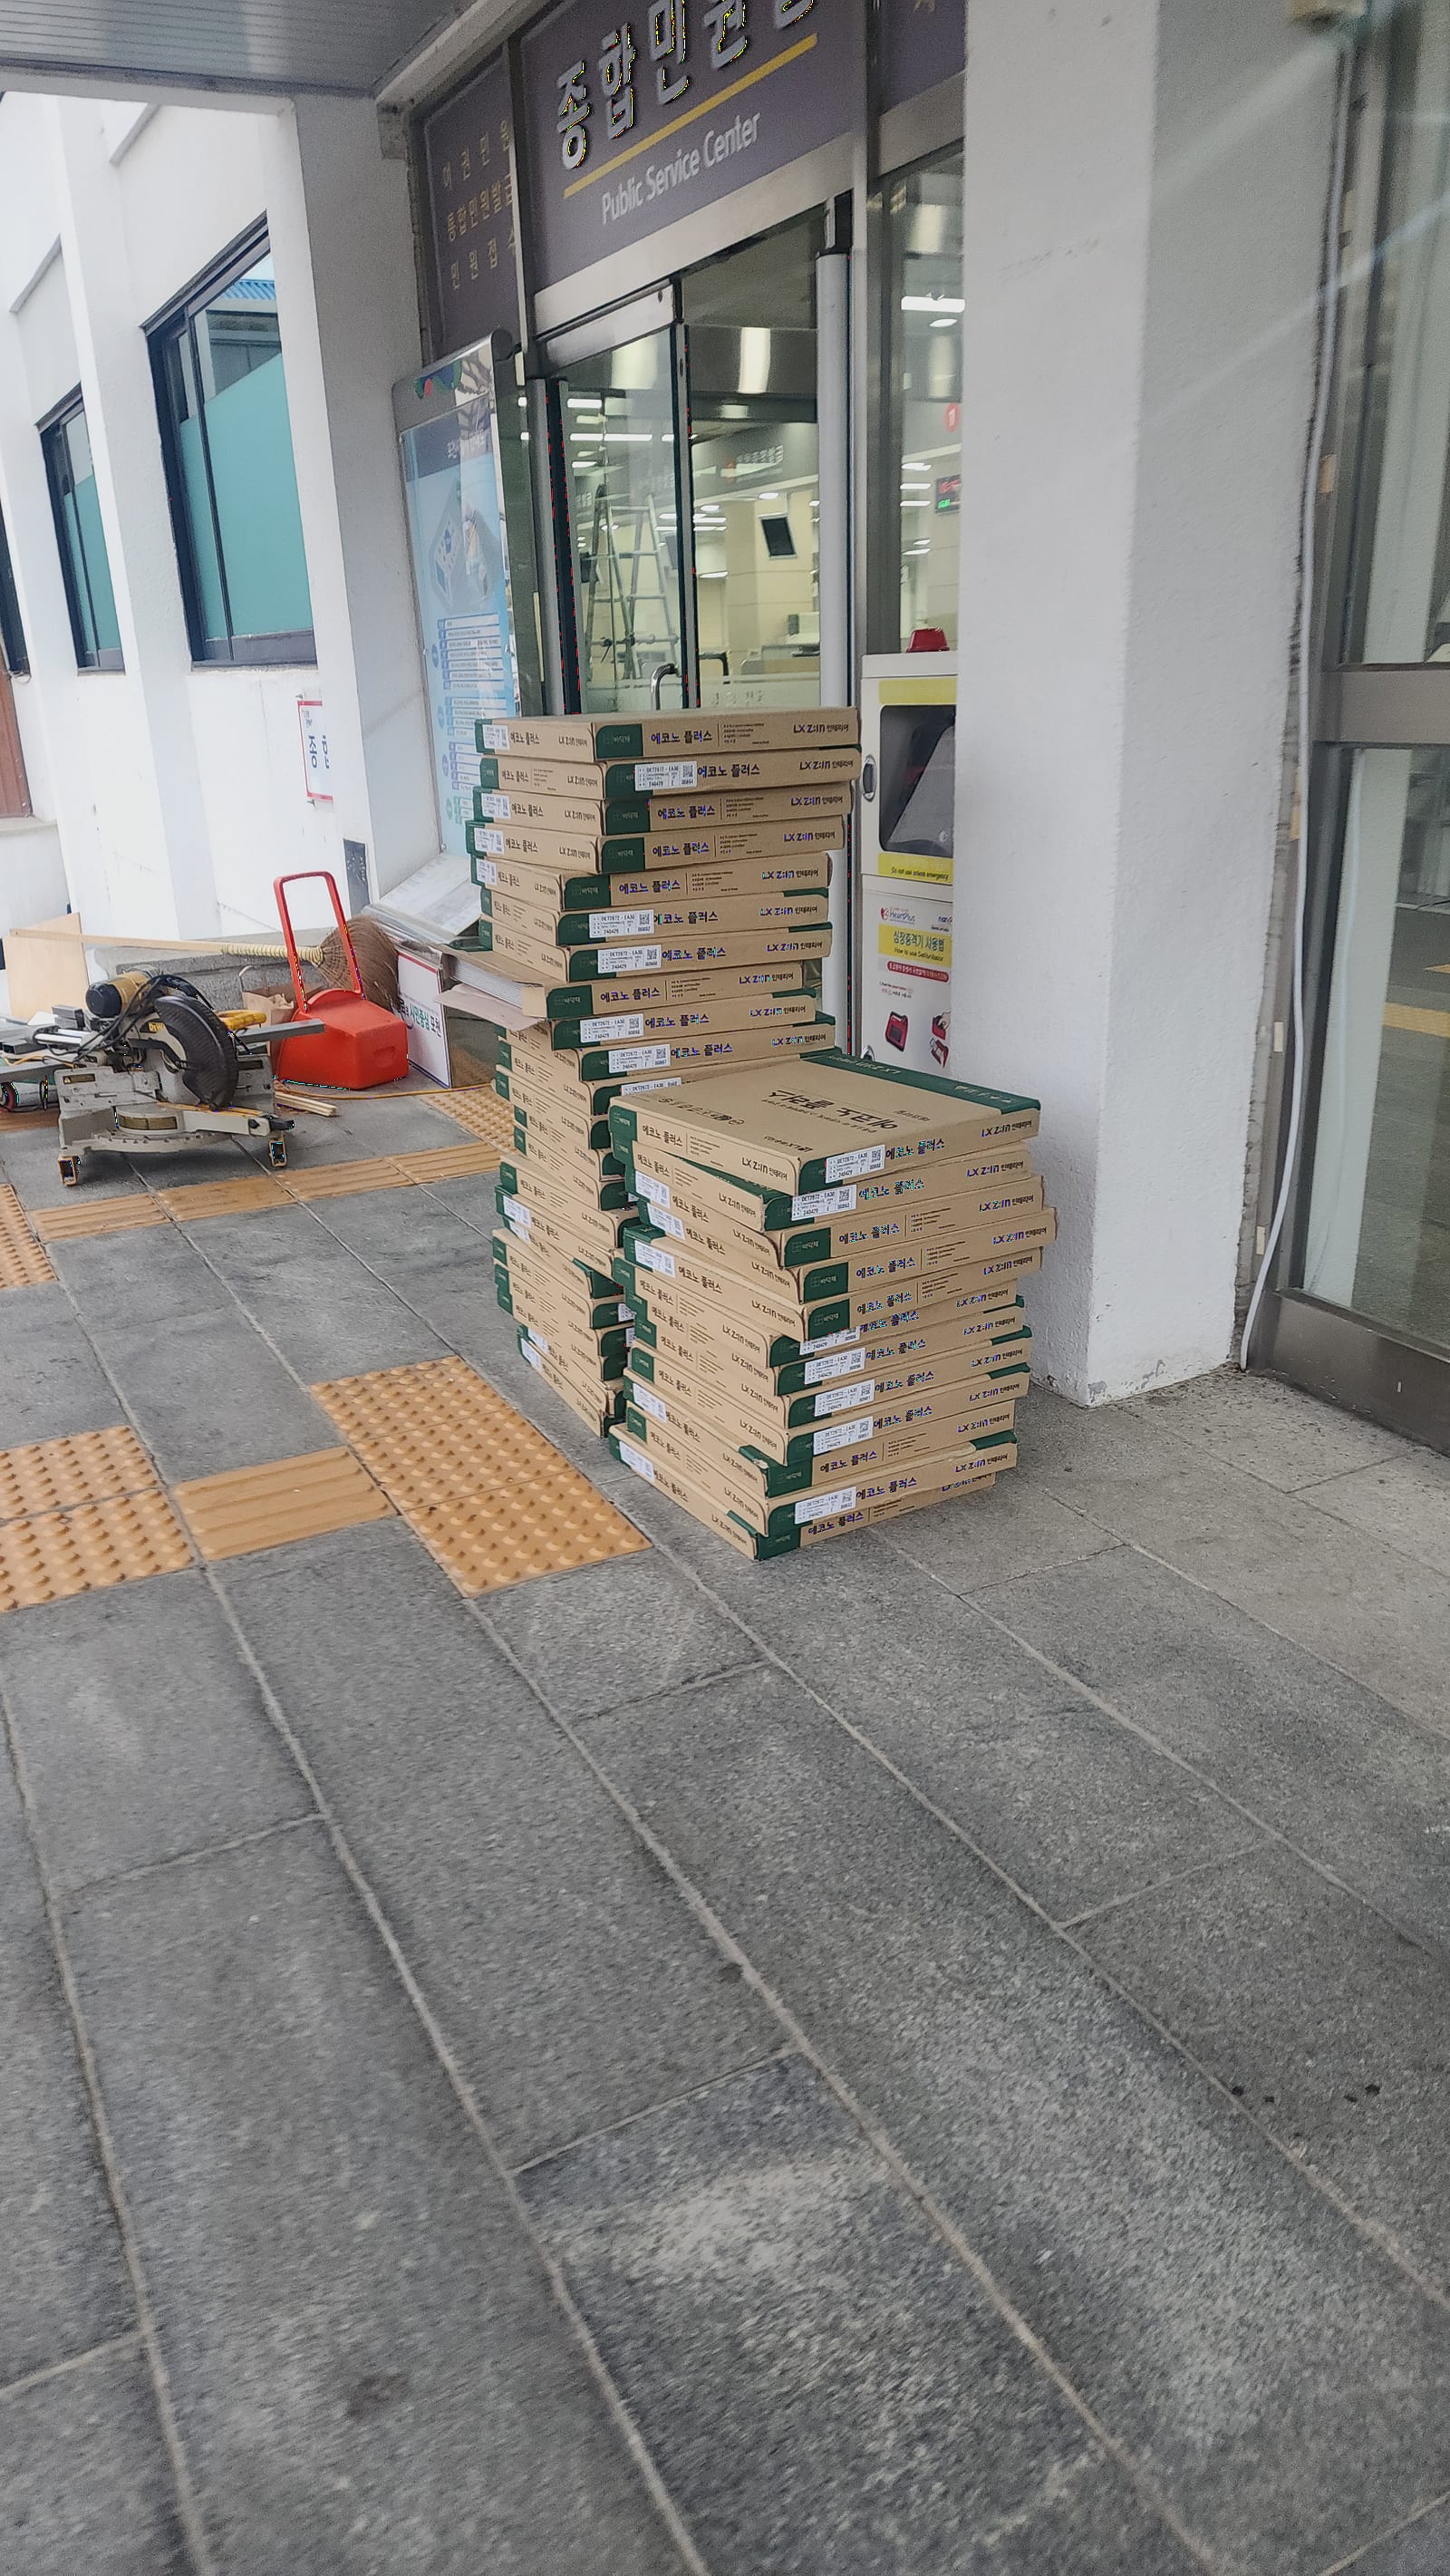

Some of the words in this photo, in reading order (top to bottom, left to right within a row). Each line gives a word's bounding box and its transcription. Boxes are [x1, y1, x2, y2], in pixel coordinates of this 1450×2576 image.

[556, 0, 816, 169] 종합민원
[602, 174, 644, 225] Public
[645, 148, 701, 201] Service
[702, 112, 761, 169] Center
[651, 733, 680, 744] 에코노
[684, 730, 712, 742] 플러스
[698, 766, 728, 779] 에코노
[730, 763, 759, 776] 플러스
[658, 808, 685, 819] 에코노
[689, 805, 715, 817] 플러스
[652, 846, 680, 857] 에코노
[683, 842, 710, 854] 플러스
[619, 882, 649, 894] 에코노
[652, 879, 681, 893] 플러스
[653, 914, 683, 925] 에코노
[687, 911, 718, 924] 플러스
[894, 930, 923, 949] 심장충격기
[925, 934, 944, 952] 사용법
[662, 949, 692, 961] 에코노
[696, 946, 726, 959] 플러스
[600, 991, 630, 1002] 에코노
[632, 987, 661, 1000] 플러스
[644, 1016, 674, 1028] 에코노
[680, 1013, 710, 1026] 플러스
[671, 1047, 701, 1059] 에코노
[704, 1044, 733, 1056] 플러스
[643, 1125, 662, 1139] 에코노
[663, 1132, 683, 1147] 플러스
[885, 1148, 914, 1159] 에코노
[917, 1139, 944, 1154] 플러스
[859, 1186, 889, 1200] 에코노
[894, 1179, 924, 1195] 플러스
[839, 1231, 867, 1244] 에코노
[871, 1224, 900, 1238] 플러스
[856, 1265, 884, 1279] 에코노
[888, 1257, 916, 1273] 플러스
[856, 1302, 883, 1314] 에코노
[886, 1292, 912, 1307] 플러스
[866, 1349, 894, 1361] 에코노
[898, 1339, 926, 1353] 플러스
[875, 1380, 903, 1393] 에코노
[906, 1370, 934, 1386] 플러스
[874, 1416, 902, 1429] 에코노
[906, 1406, 933, 1421] 플러스
[820, 1460, 846, 1472] 에코노
[851, 1451, 877, 1466] 플러스
[856, 1487, 884, 1500] 에코노
[888, 1477, 917, 1493] 플러스
[837, 1512, 864, 1527] 플러스
